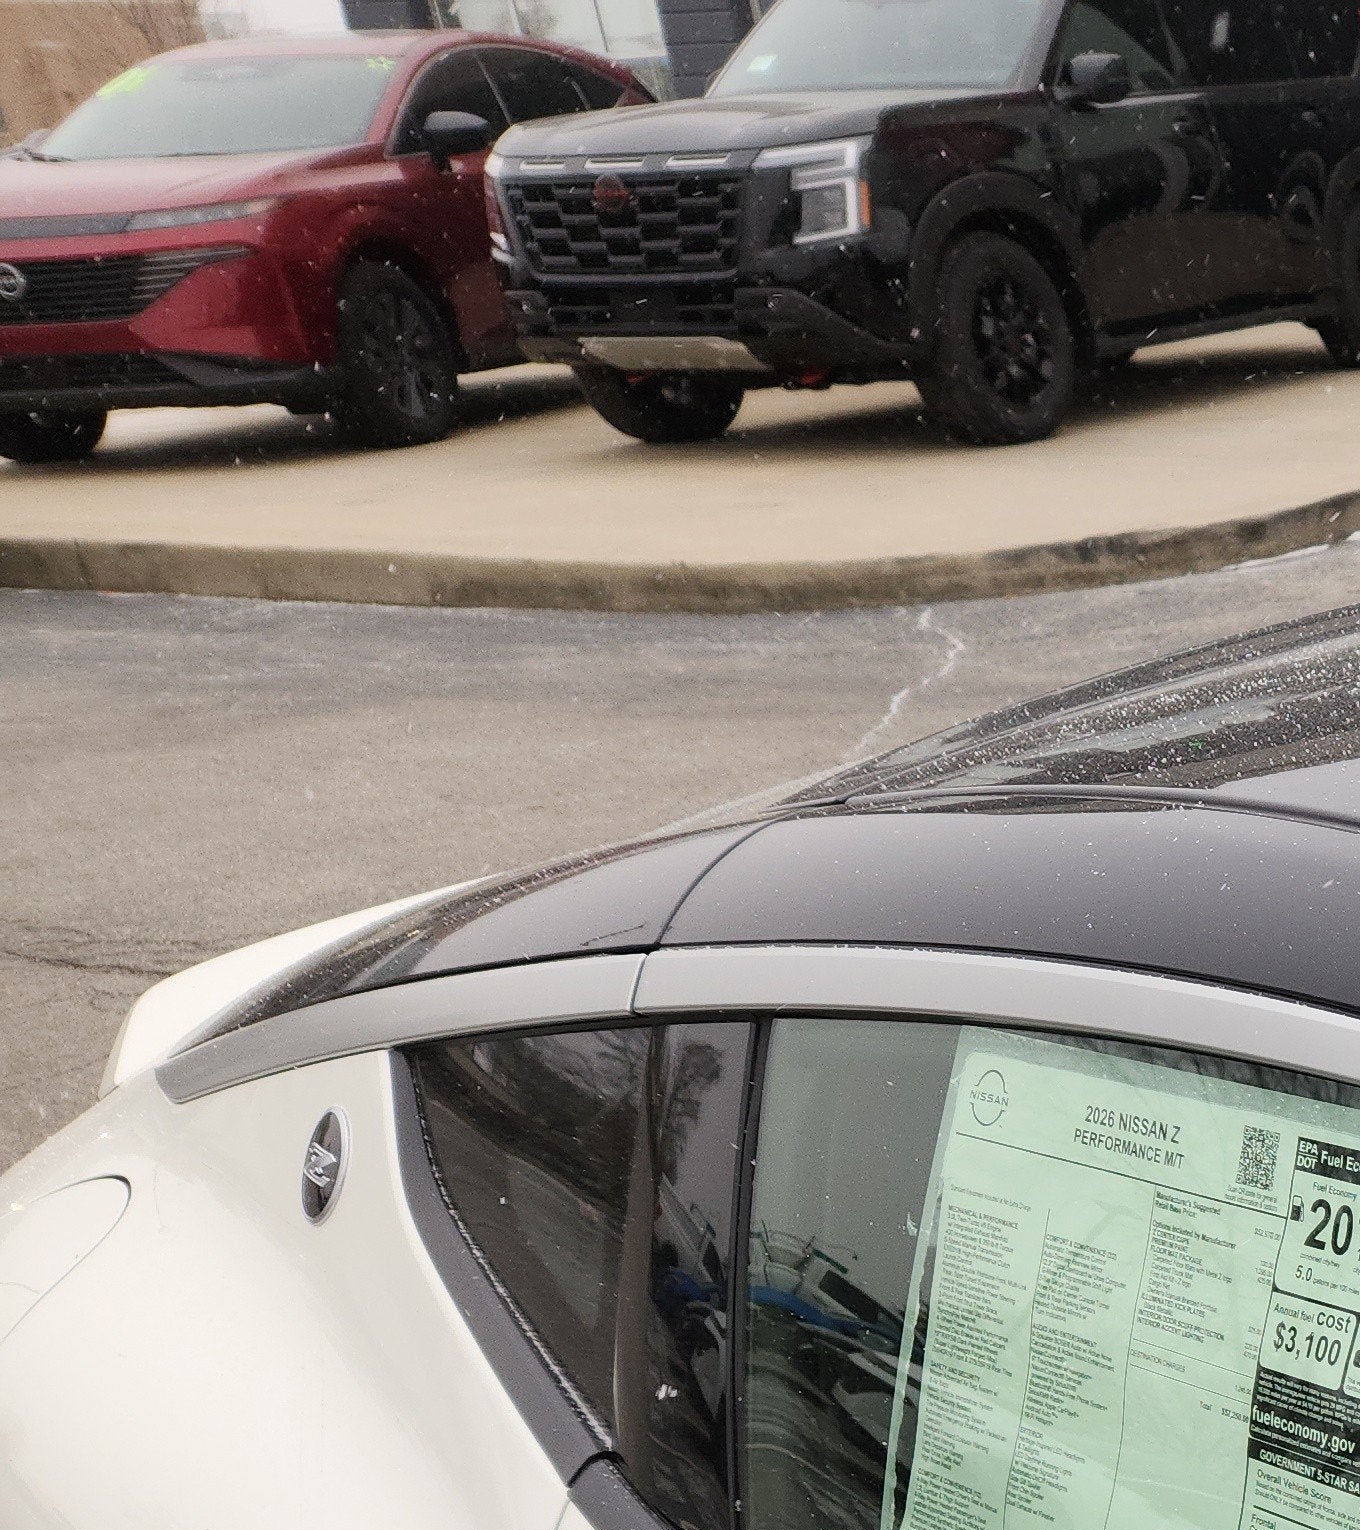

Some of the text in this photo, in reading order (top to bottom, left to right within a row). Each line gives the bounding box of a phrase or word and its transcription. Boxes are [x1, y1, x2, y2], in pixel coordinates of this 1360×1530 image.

[970, 1090, 1009, 1106] NISSAN
[1084, 1105, 1180, 1144] 2026 NISSAN Z
[1074, 1128, 1184, 1168] PERFORMANCE M/T
[1296, 1154, 1317, 1170] DOT
[1298, 1142, 1320, 1155] EPA
[1320, 1150, 1344, 1168] Fuel
[1312, 1182, 1358, 1201] Fuel Economy
[1304, 1198, 1354, 1256] 20
[1273, 1302, 1352, 1333] Annual fuel cost
[1272, 1320, 1342, 1366] $3,100
[1252, 1404, 1356, 1460] fueleconomy.gov
[1258, 1446, 1314, 1480] GOVERNMENT
[1316, 1468, 1348, 1490] 5-STAR
[1256, 1468, 1332, 1504] Overall Vehicle Score
[1250, 1512, 1276, 1530] Frontal
